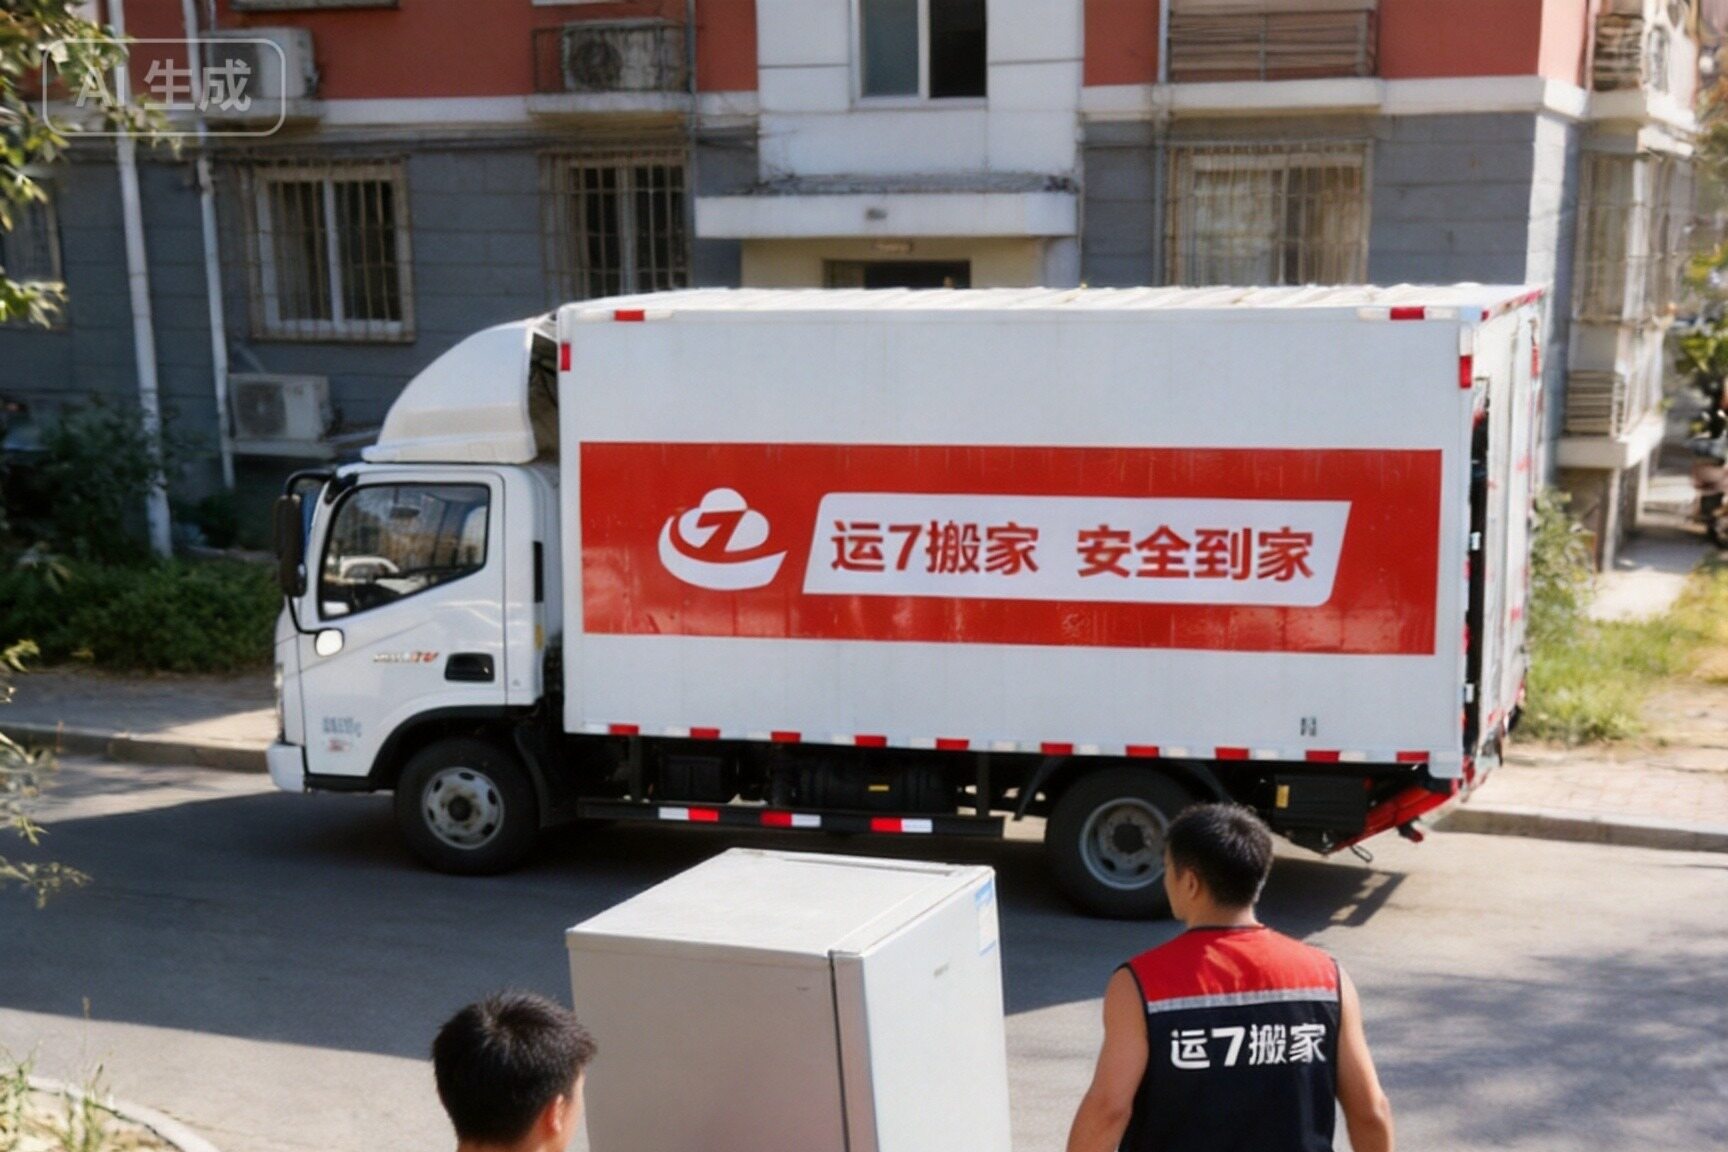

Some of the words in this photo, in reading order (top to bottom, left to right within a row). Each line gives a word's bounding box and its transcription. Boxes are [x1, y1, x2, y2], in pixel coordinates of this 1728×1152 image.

[830, 520, 1039, 576] 运7搬家
[1076, 524, 1315, 582] 安全到家
[1170, 1023, 1326, 1069] 运7搬家
